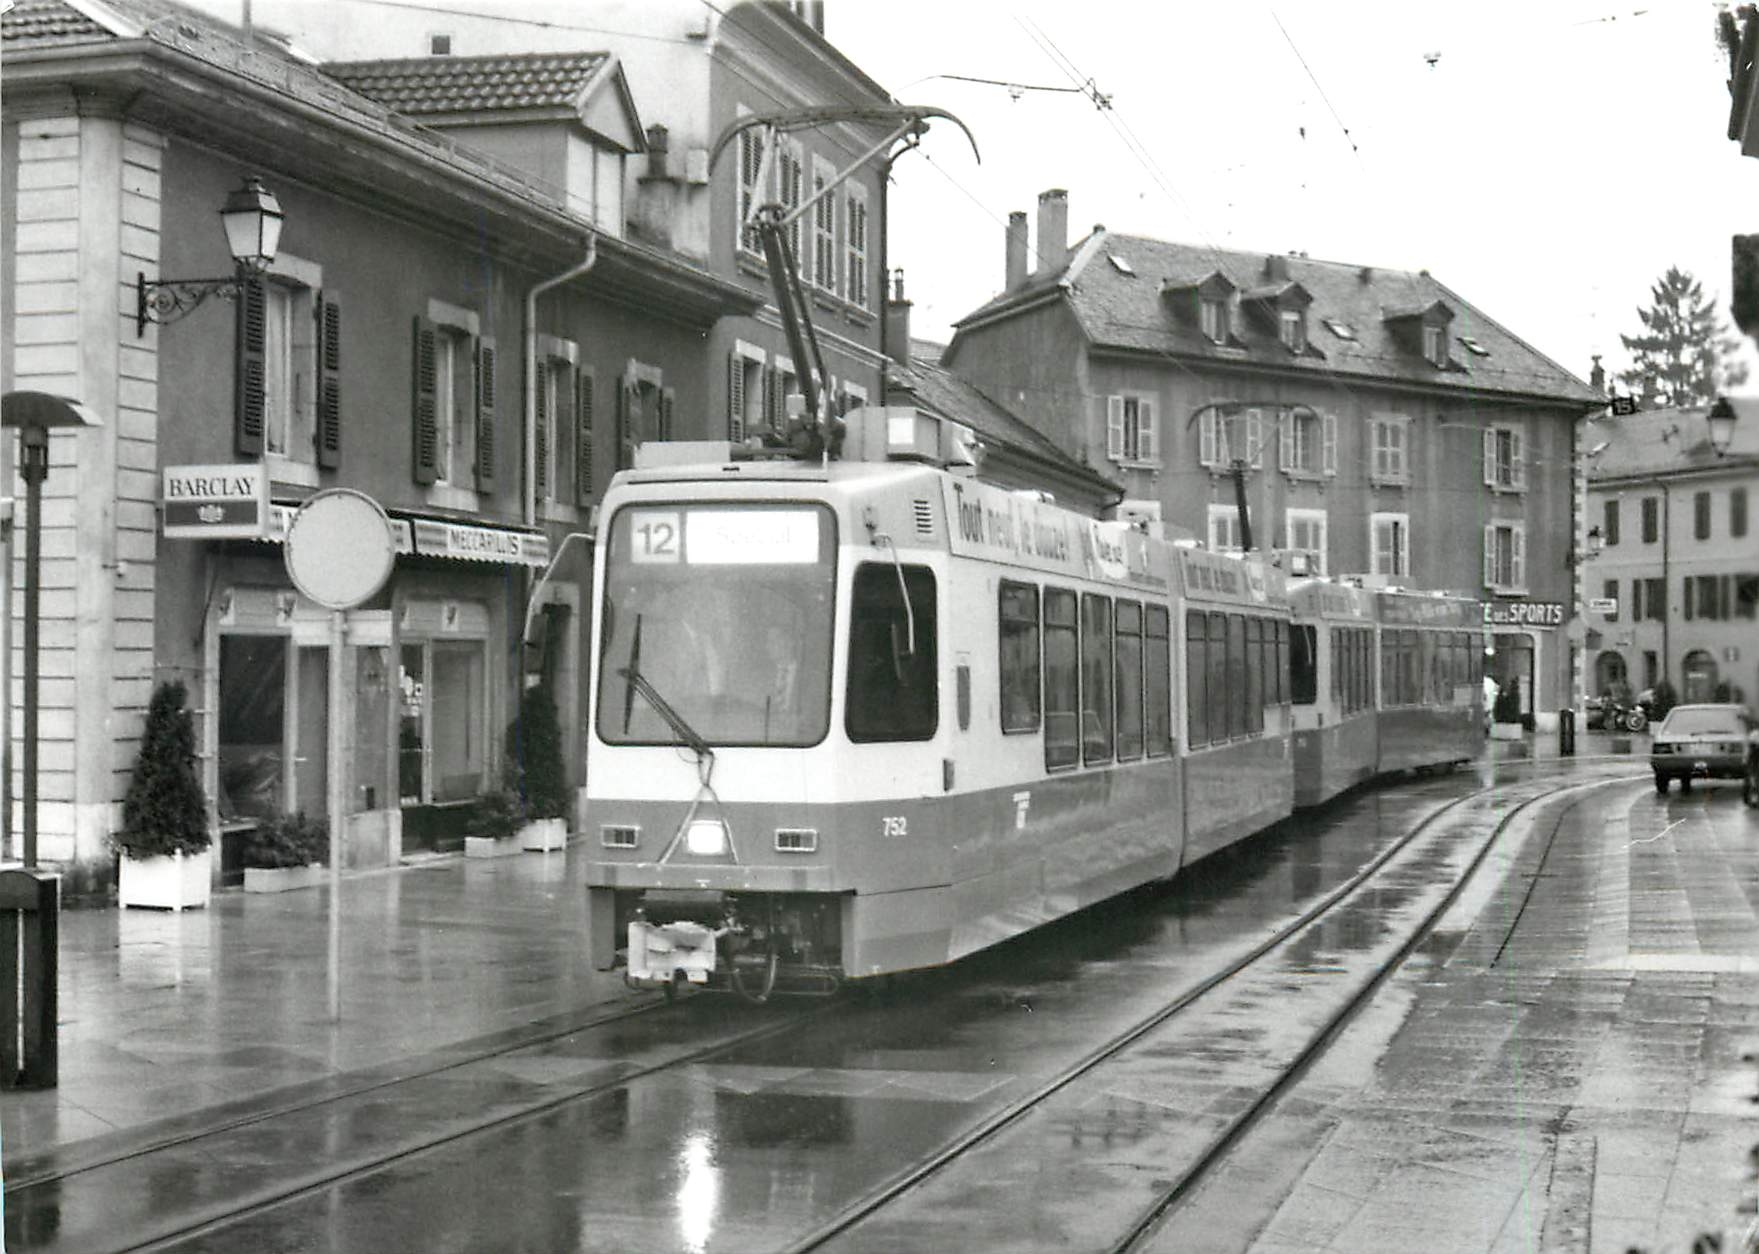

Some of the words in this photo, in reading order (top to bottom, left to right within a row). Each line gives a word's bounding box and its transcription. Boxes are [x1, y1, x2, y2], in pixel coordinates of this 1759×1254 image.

[169, 477, 254, 497] BARCLAY
[953, 482, 985, 544] Tout
[637, 522, 675, 555] 12
[1509, 602, 1564, 624] SPORTS
[882, 816, 907, 836] 752
